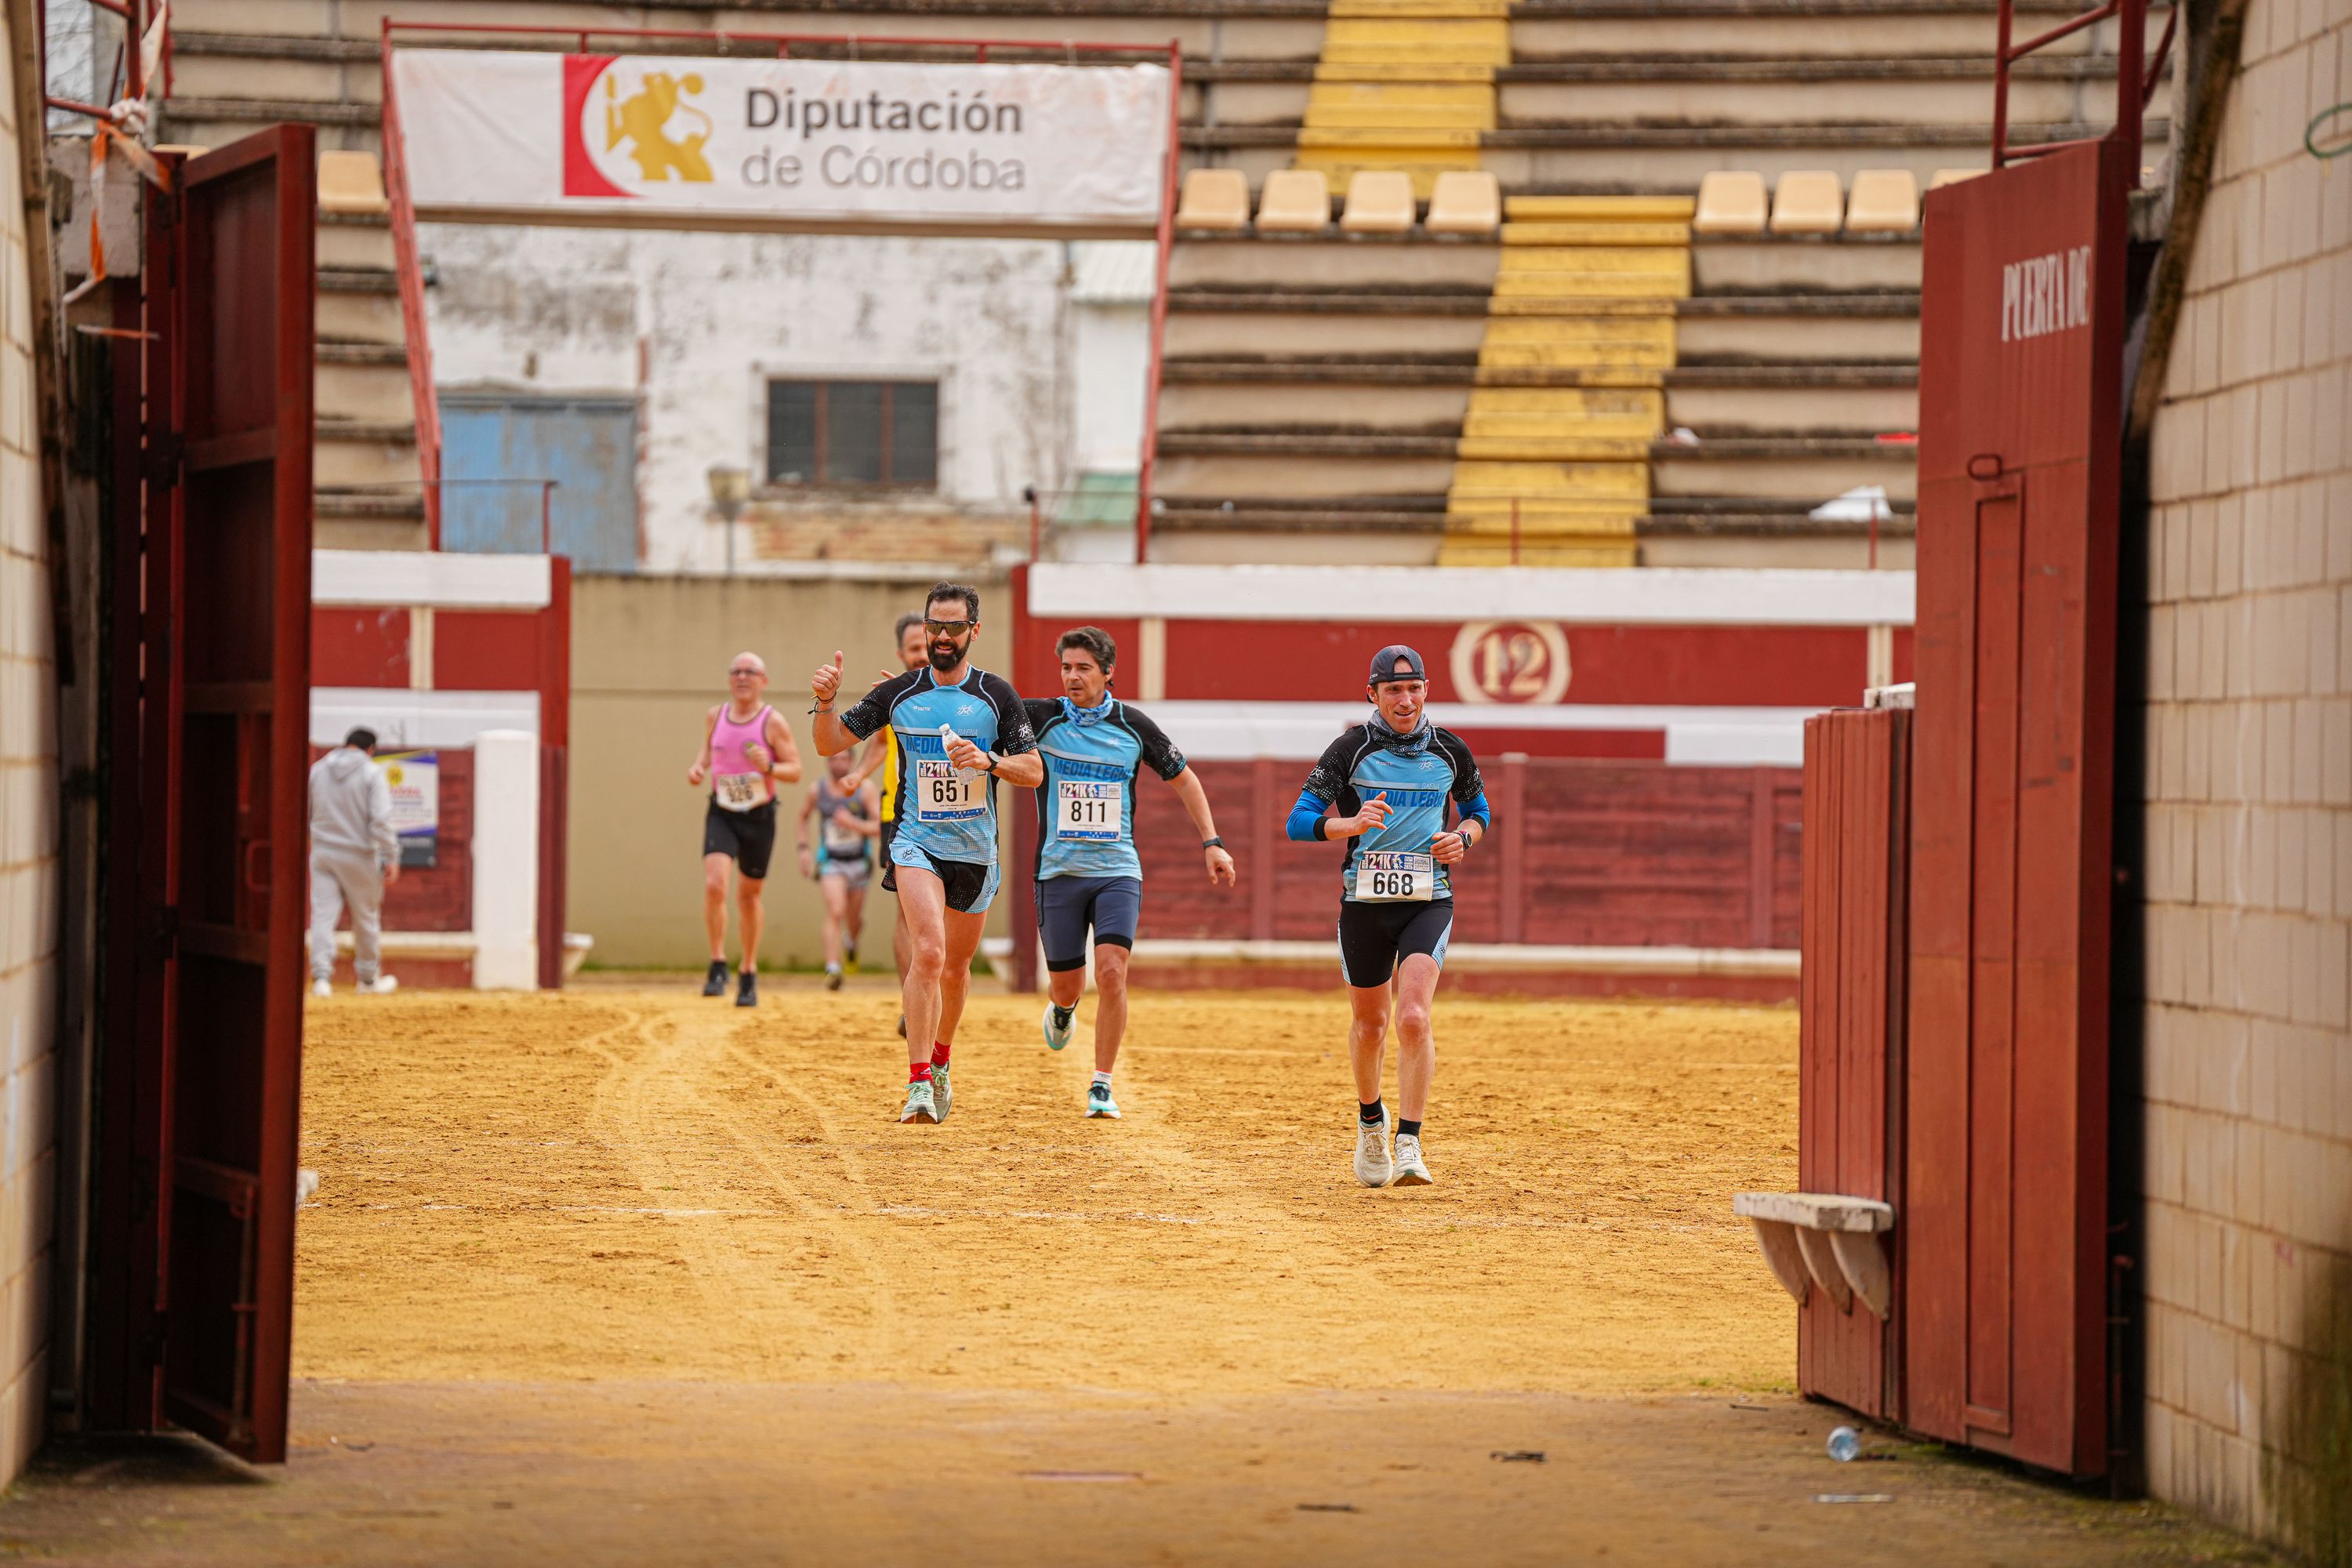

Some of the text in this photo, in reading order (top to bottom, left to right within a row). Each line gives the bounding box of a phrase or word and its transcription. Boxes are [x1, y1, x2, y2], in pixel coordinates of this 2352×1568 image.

[745, 87, 1023, 140] Diputación
[741, 144, 1026, 191] de Córdoba
[1479, 632, 1548, 696] 12
[906, 736, 943, 754] MEDIA
[927, 763, 949, 778] 21K
[1054, 758, 1092, 778] MEDIA
[932, 779, 968, 803] 651
[1066, 783, 1087, 798] 21K
[1071, 800, 1105, 822] 811
[1369, 854, 1392, 869] 21K
[1373, 872, 1414, 896] 668
